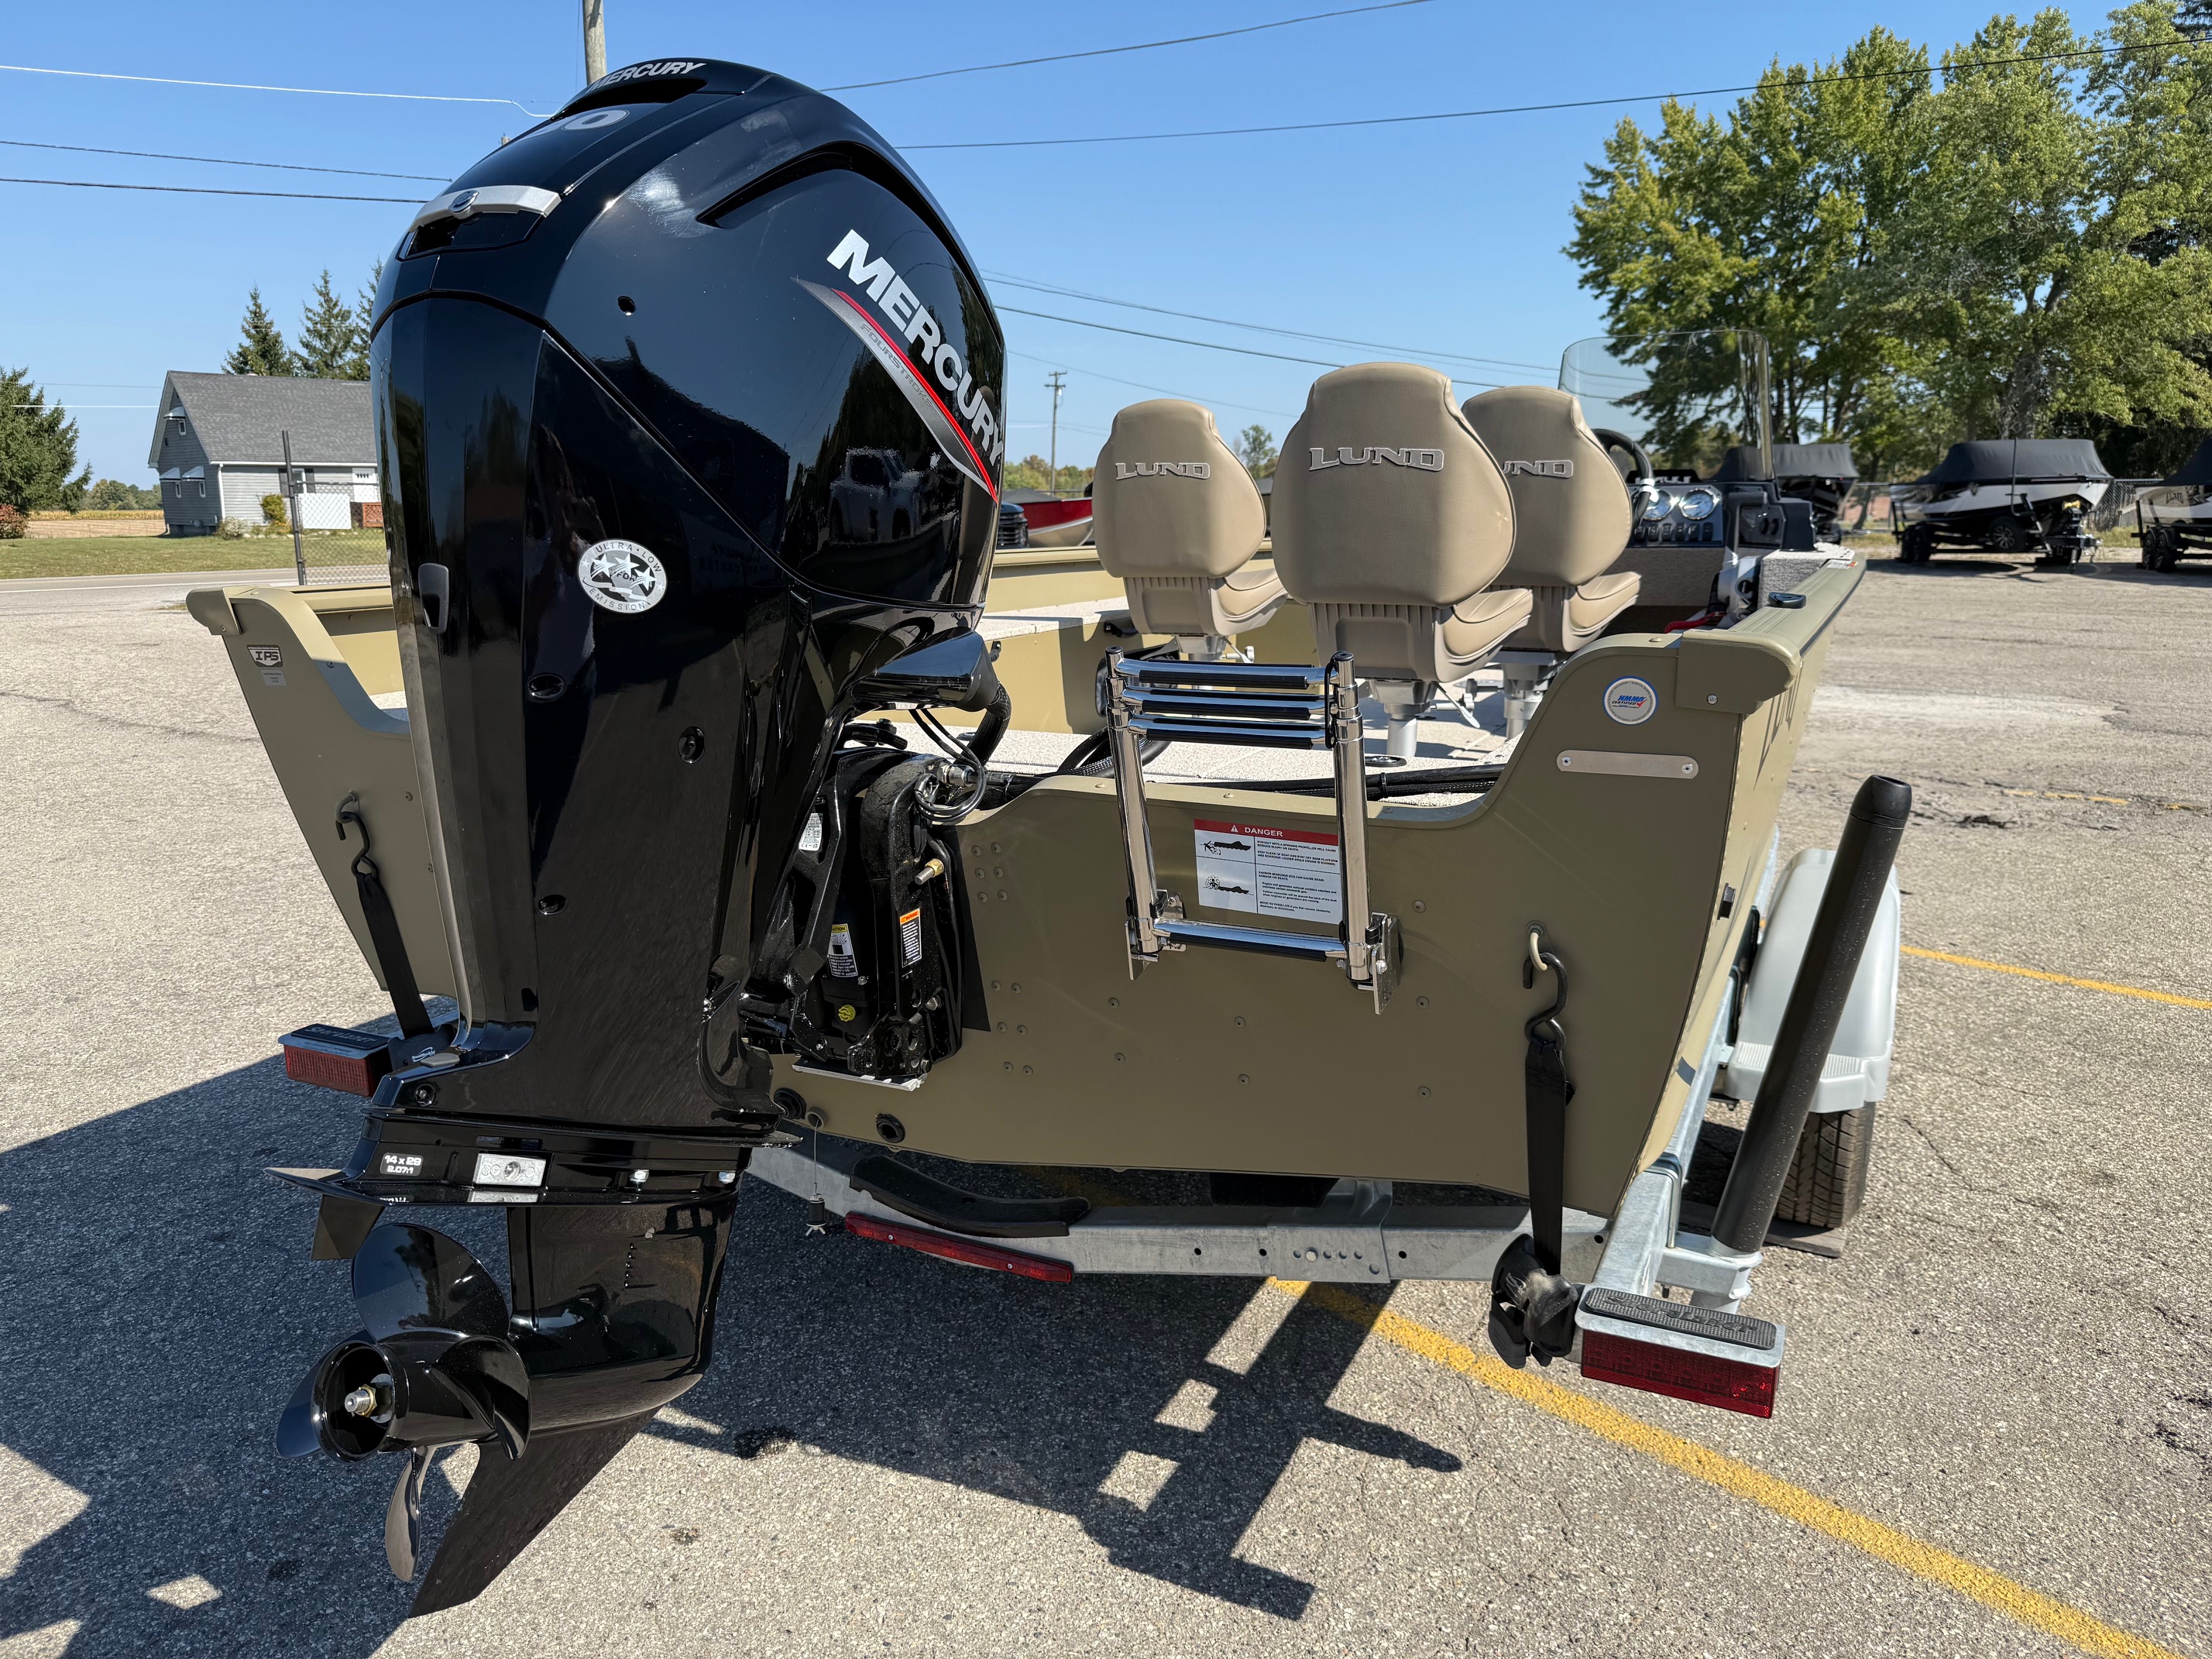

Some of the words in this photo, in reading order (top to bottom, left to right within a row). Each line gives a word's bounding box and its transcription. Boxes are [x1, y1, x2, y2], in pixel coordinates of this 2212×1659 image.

[586, 61, 706, 94] MERCURY
[826, 229, 1004, 466] MERCURY
[860, 321, 933, 407] FOURSTROKE
[1309, 448, 1445, 472] LUND
[1115, 462, 1211, 480] LUND
[641, 551, 662, 572] LOW
[255, 651, 279, 661] IPS
[1245, 826, 1283, 837] DANGER
[384, 1155, 398, 1164] 14
